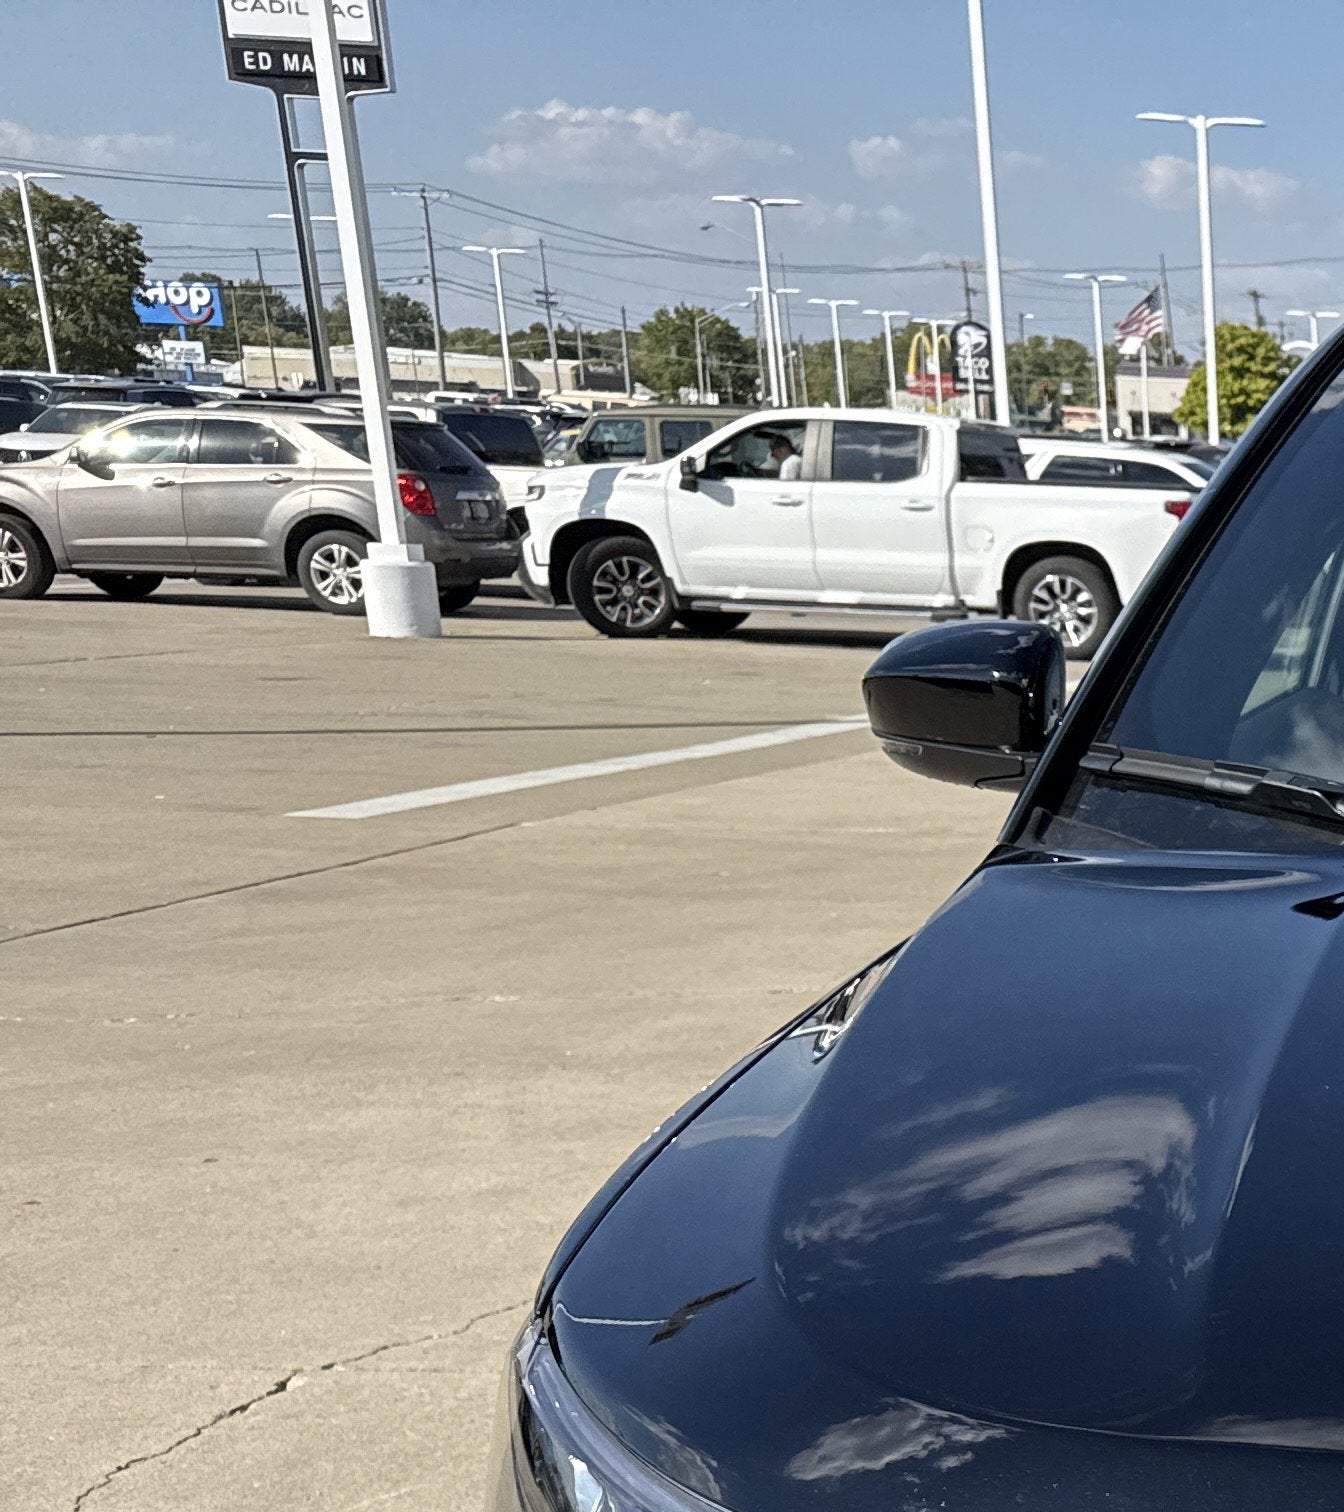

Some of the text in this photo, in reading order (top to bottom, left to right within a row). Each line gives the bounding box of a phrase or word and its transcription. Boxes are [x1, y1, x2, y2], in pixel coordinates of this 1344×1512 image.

[231, 0, 364, 19] CADILAC
[243, 51, 367, 76] ED MAIN
